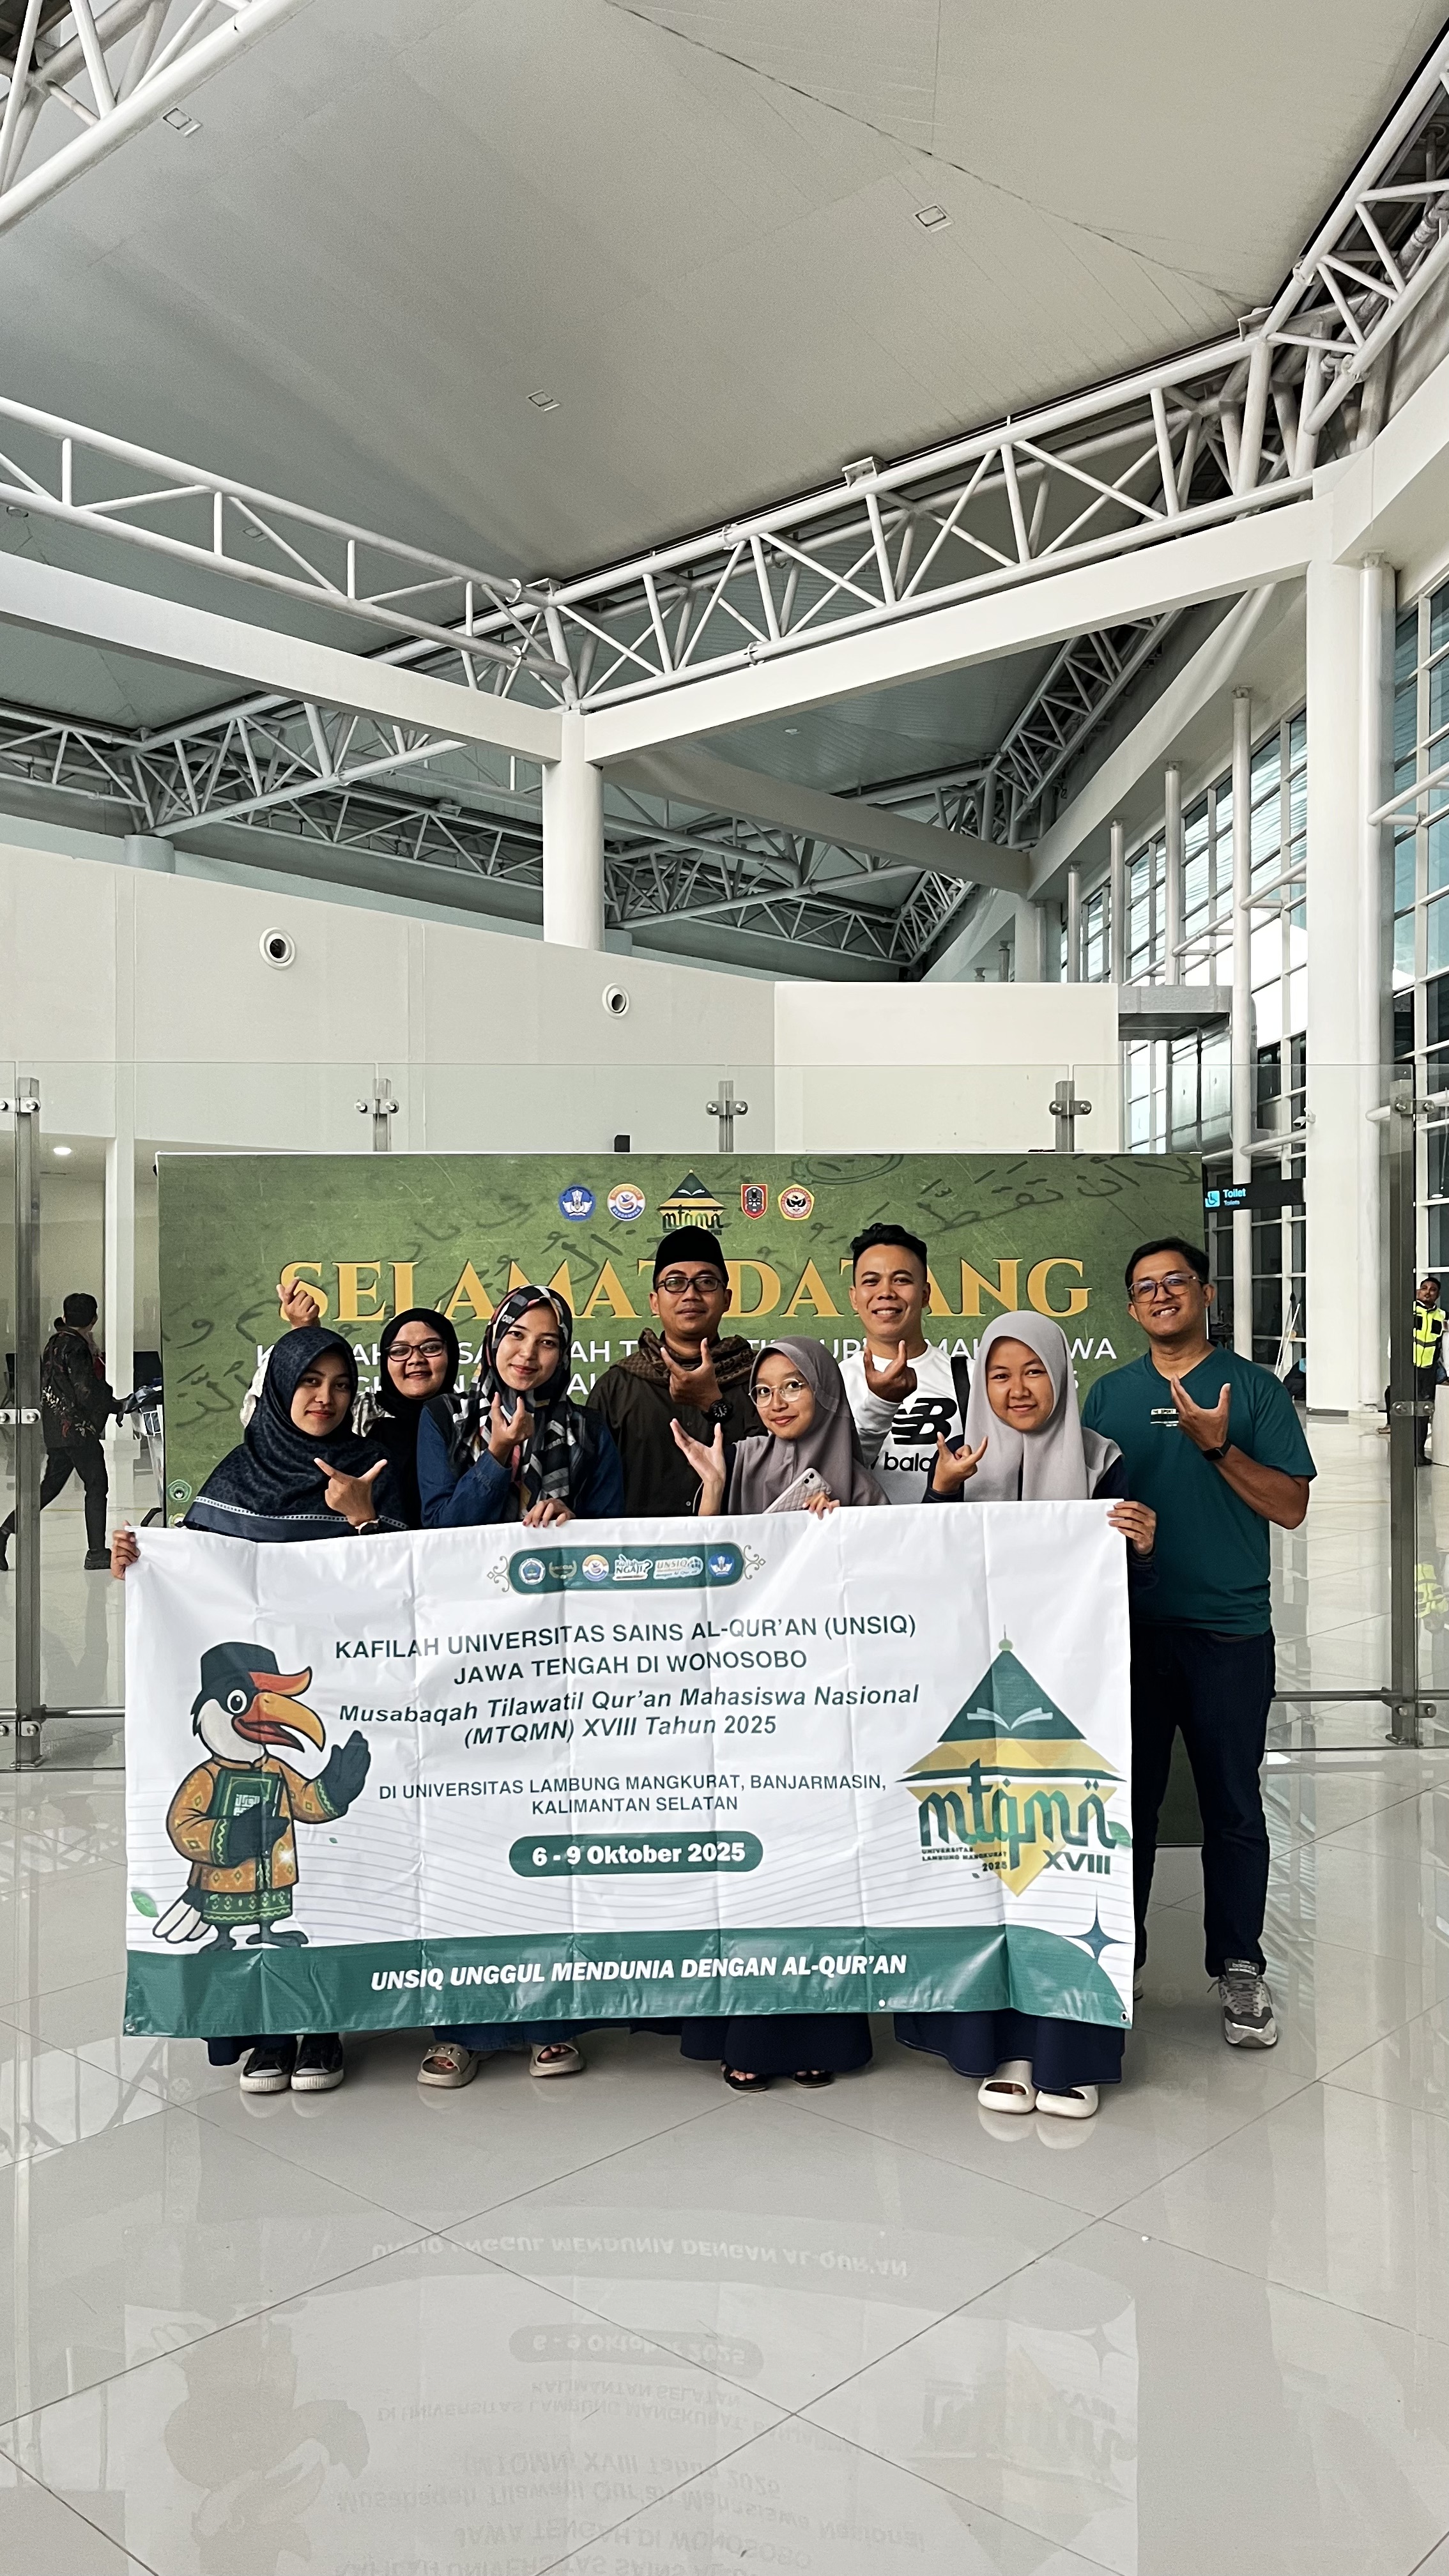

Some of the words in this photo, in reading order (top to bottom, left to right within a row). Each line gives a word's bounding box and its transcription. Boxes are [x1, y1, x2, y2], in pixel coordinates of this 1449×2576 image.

[1222, 1188, 1246, 1199] Toilet
[279, 1259, 661, 1321] SELAMA
[721, 1257, 1091, 1319] DAANG
[884, 1451, 931, 1472] bala
[335, 1638, 440, 1659] KAFILAH
[447, 1625, 605, 1654] UNIVERSITAS
[612, 1623, 684, 1642] SAINS
[824, 1614, 917, 1640] (UNSIQ)
[454, 1662, 524, 1685] JAWA
[531, 1656, 629, 1677] TENGAH
[637, 1655, 659, 1674] DI
[666, 1650, 808, 1673] WONOSOBO
[339, 1702, 479, 1726] Musabaqah
[486, 1691, 584, 1718] Tilawatil
[679, 1685, 806, 1706] Mahasiswa
[814, 1683, 920, 1706] Nasional
[464, 1718, 575, 1749] (MTQMN)
[582, 1716, 638, 1737] XVIII
[646, 1715, 717, 1736] Tahun
[723, 1714, 777, 1735] 2025
[379, 1786, 397, 1800] DI
[402, 1779, 524, 1798] UNIVERSITAS
[529, 1777, 620, 1794] LAMBUNG
[625, 1774, 745, 1791] MANGKURAT,
[750, 1774, 887, 1791] BANJARMASIN,
[532, 1797, 650, 1815] KALIMANTAN
[656, 1795, 738, 1812] SELATAN
[531, 1846, 547, 1867] 6
[567, 1845, 581, 1866] 9
[586, 1843, 682, 1866] Oktober
[687, 1841, 746, 1863] 2025
[982, 1861, 1008, 1872] 2025
[1042, 1850, 1111, 1875] XVIII
[370, 1968, 443, 1991] UNSIQ
[449, 1964, 544, 1986] UNGGUL
[551, 1958, 676, 1983] MENDUNIA
[680, 1956, 774, 1979] DENGAN
